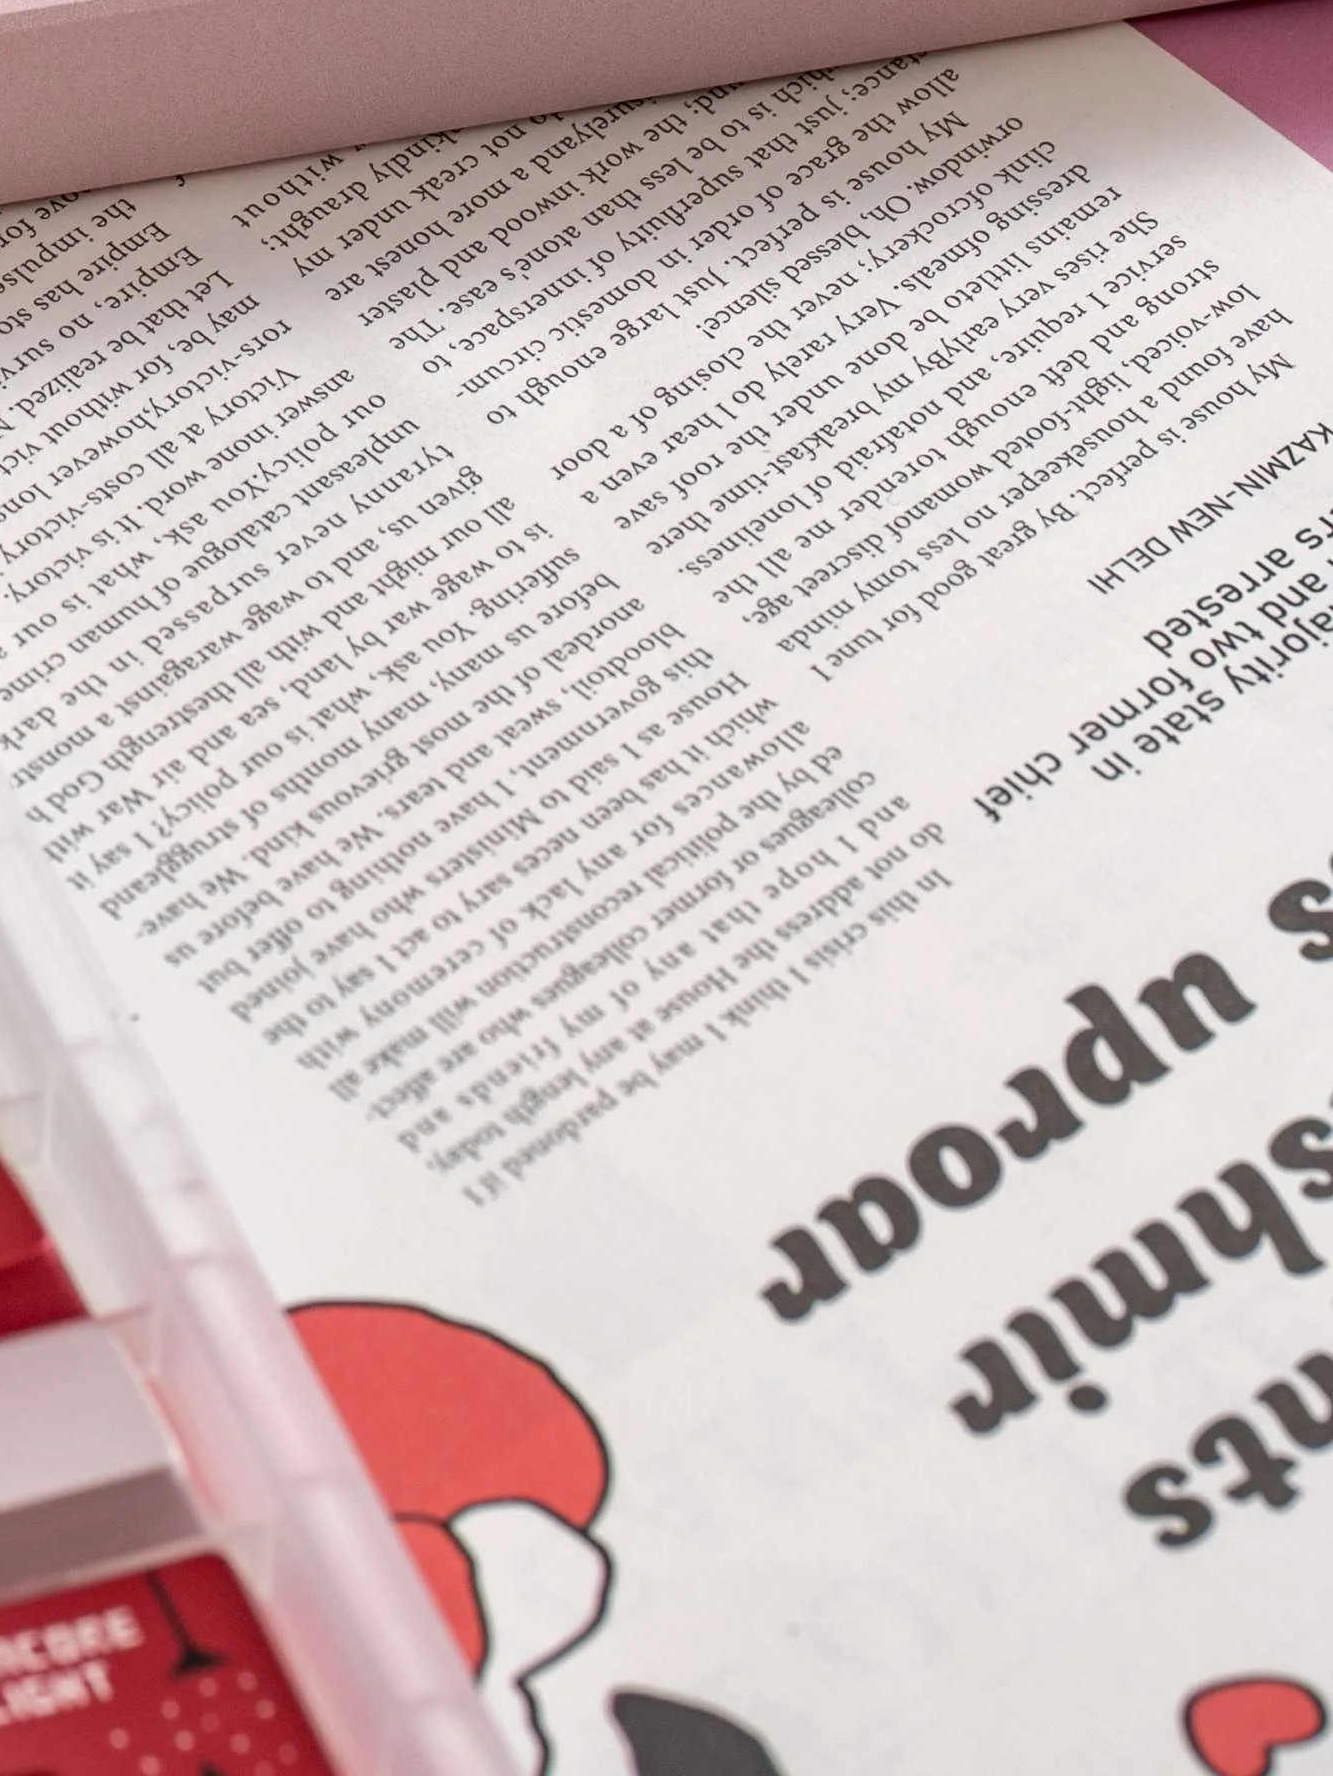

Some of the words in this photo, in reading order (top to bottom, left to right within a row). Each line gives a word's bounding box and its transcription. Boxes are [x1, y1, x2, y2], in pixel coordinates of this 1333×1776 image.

[906, 117, 1022, 194] orwindow.
[860, 195, 910, 221] Oh,
[1109, 211, 1158, 243] She
[779, 224, 870, 284] blessed
[1053, 240, 1109, 280] rises
[695, 277, 780, 339] silence!
[999, 281, 1056, 318] very
[912, 316, 998, 376] earlyBy
[1121, 282, 1260, 374] low-voiced,
[1230, 308, 1293, 348] have
[872, 372, 914, 403] my
[1157, 346, 1234, 402] found
[1246, 352, 1295, 384] My
[204, 368, 301, 426] Victory
[274, 369, 354, 427] answer
[990, 371, 1131, 469] light-footed
[1139, 395, 1158, 408] a
[1180, 379, 1256, 429] house
[145, 440, 178, 469] all
[177, 423, 204, 444] at
[205, 423, 278, 470] inone
[709, 400, 882, 512] breakfast-time
[998, 407, 1148, 507] housekeeper
[1157, 427, 1186, 445] is
[1069, 438, 1158, 501] perfect.
[1168, 422, 1332, 543] KAZMIN-NEW
[136, 470, 207, 517] word.
[883, 463, 993, 543] womanof
[963, 504, 997, 528] no
[1035, 501, 1078, 528] By
[91, 528, 120, 546] is
[113, 513, 143, 532] It
[645, 511, 711, 554] there
[916, 527, 970, 560] less
[976, 520, 1036, 567] great
[3, 546, 93, 603] victory.
[792, 533, 885, 597] discreet
[853, 559, 919, 602] tomy
[917, 559, 977, 610] good
[1087, 536, 1171, 593] DELHI
[742, 593, 792, 623] age,
[881, 603, 922, 631] for
[1143, 548, 1294, 657] arrested
[1257, 573, 1327, 627] and
[775, 598, 854, 651] minda
[825, 628, 883, 666] tune
[1190, 621, 1264, 667] two
[809, 664, 832, 682] I
[1069, 667, 1194, 754] former
[1133, 690, 1224, 753] state
[974, 752, 1061, 822] chief
[1091, 751, 1140, 780] in
[761, 954, 1257, 1324] uproar
